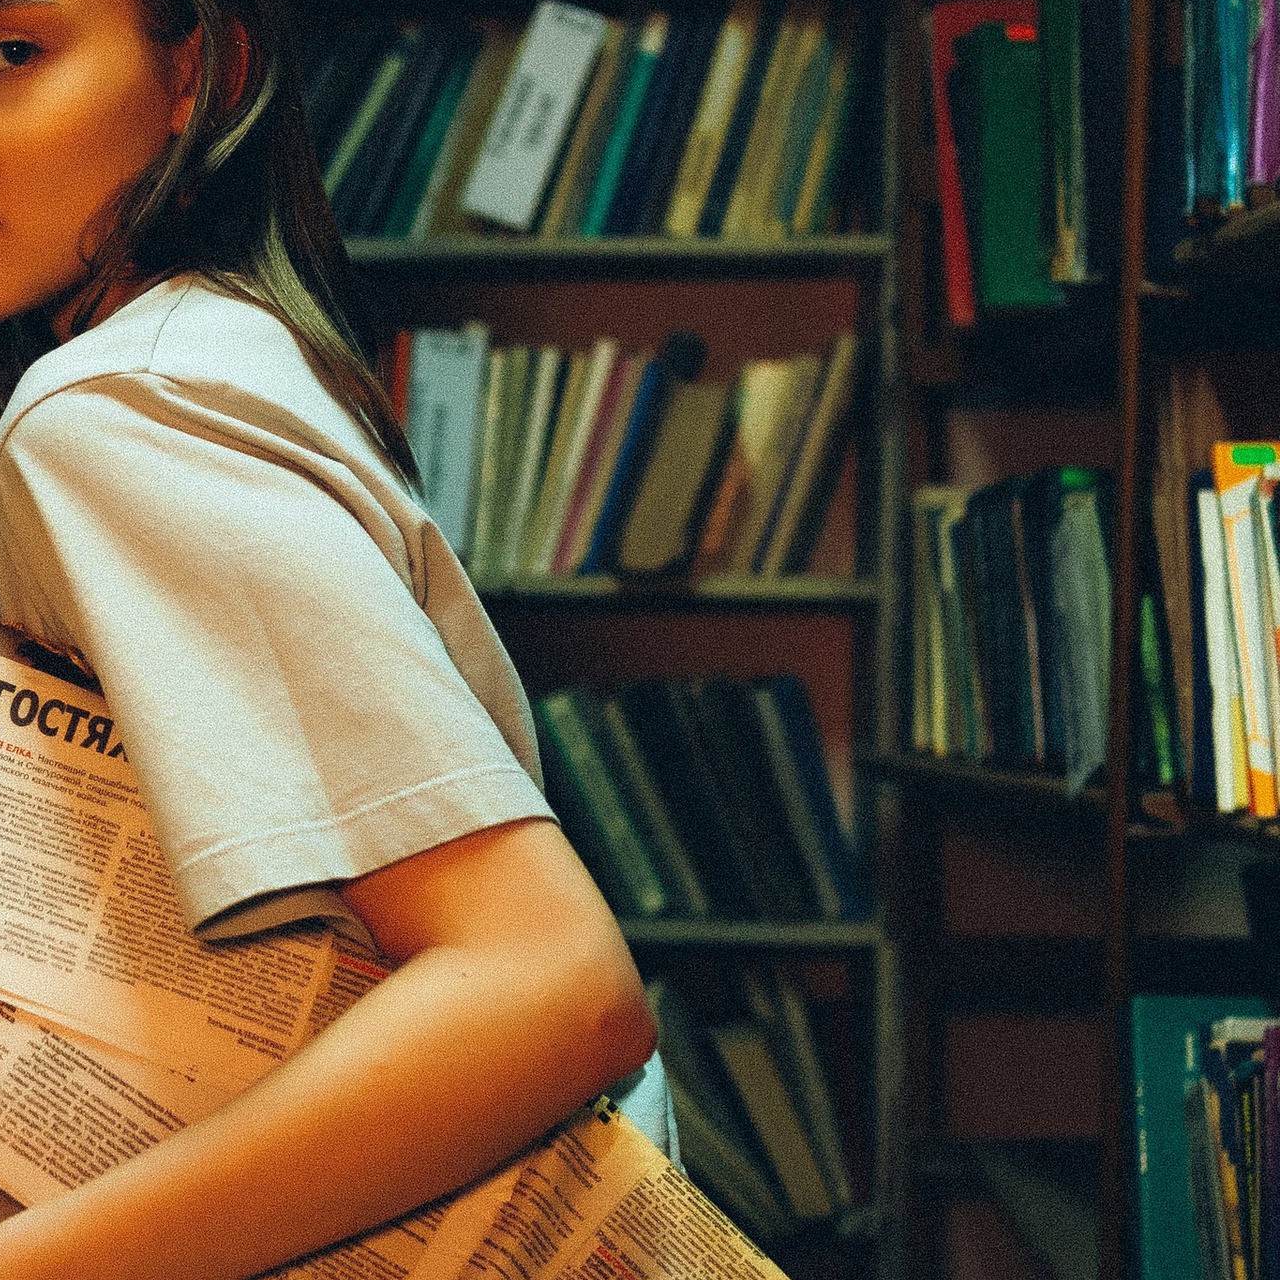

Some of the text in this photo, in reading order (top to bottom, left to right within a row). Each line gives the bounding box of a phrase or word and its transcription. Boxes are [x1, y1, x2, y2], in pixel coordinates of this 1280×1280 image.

[5, 743, 35, 759] ЕЛКА.
[30, 774, 75, 797] казачьего
[594, 1228, 619, 1255] Ради
